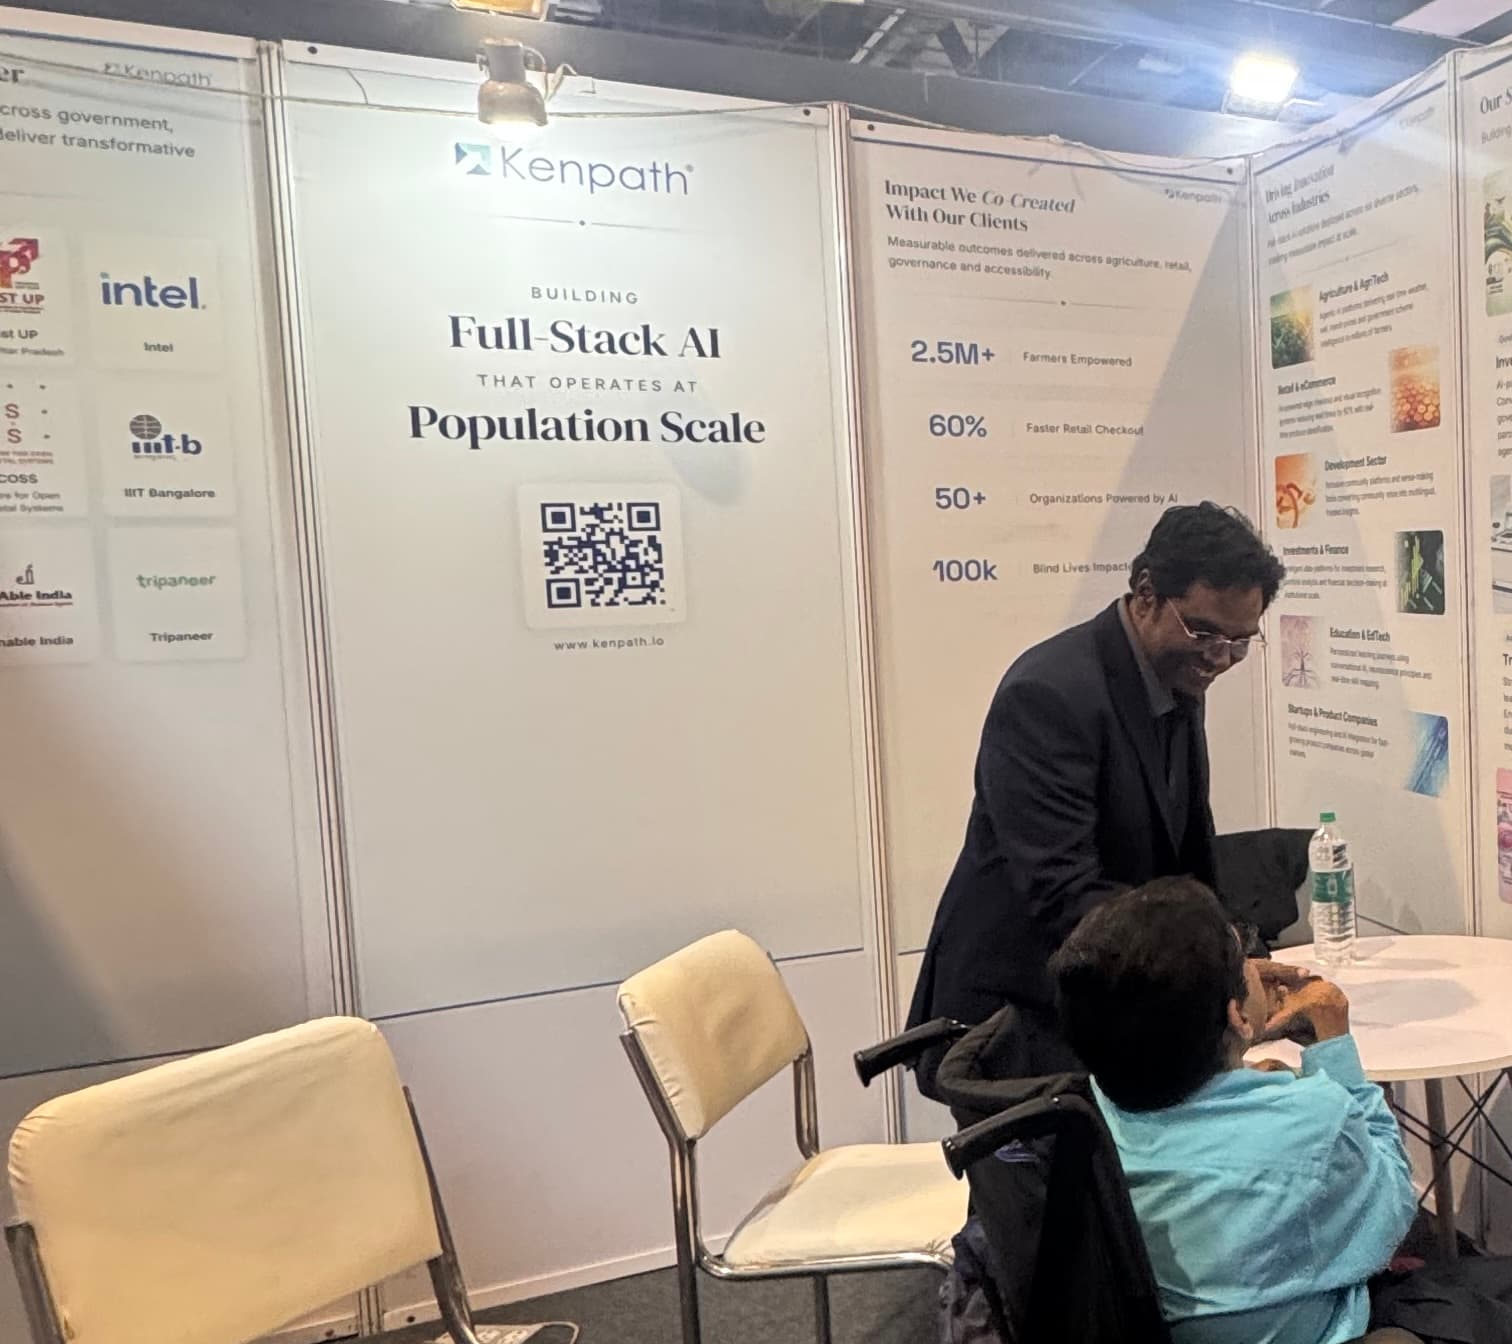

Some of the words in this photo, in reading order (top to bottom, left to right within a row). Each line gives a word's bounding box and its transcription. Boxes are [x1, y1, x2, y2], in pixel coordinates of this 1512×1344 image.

[124, 64, 210, 86] Kenpath
[1480, 95, 1503, 115] Our
[57, 109, 174, 133] government,
[1481, 123, 1512, 144] Building
[62, 134, 196, 158] transformative
[501, 146, 688, 195] Kenpath
[885, 180, 947, 202] Impact
[951, 187, 977, 204] We
[888, 204, 928, 223] With
[933, 208, 966, 227] Our
[970, 212, 1029, 232] Clients
[531, 286, 639, 305] BUILDING
[144, 342, 174, 353] Intel
[448, 314, 668, 356] Full-Stack
[678, 327, 721, 358] AI
[910, 339, 995, 365] 2.5M+
[1023, 351, 1067, 365] Farmers
[1071, 354, 1132, 368] Empowered
[478, 374, 537, 389] THAT
[549, 376, 662, 392] OPERATES
[673, 380, 698, 393] AT
[408, 405, 651, 449] Population
[660, 410, 766, 444] Scale
[929, 414, 988, 438] 60%
[1026, 423, 1060, 434] Faster
[1063, 423, 1093, 435] Retail
[1095, 425, 1144, 436] Checkout
[935, 487, 986, 510] 50+
[1029, 493, 1103, 505] Organizations
[1106, 494, 1150, 504] Powered
[1153, 493, 1166, 505] by
[1168, 494, 1178, 503] AI
[136, 574, 216, 589] tripaneer
[933, 559, 998, 582] 100k
[1033, 563, 1060, 574] Blind
[1063, 562, 1090, 574] Lives
[36, 590, 72, 600] India
[150, 632, 213, 643] Tripaneer
[1330, 627, 1360, 640] Education
[1288, 703, 1312, 717] Startups
[1319, 708, 1342, 721] Product
[1344, 710, 1378, 727] Companies
